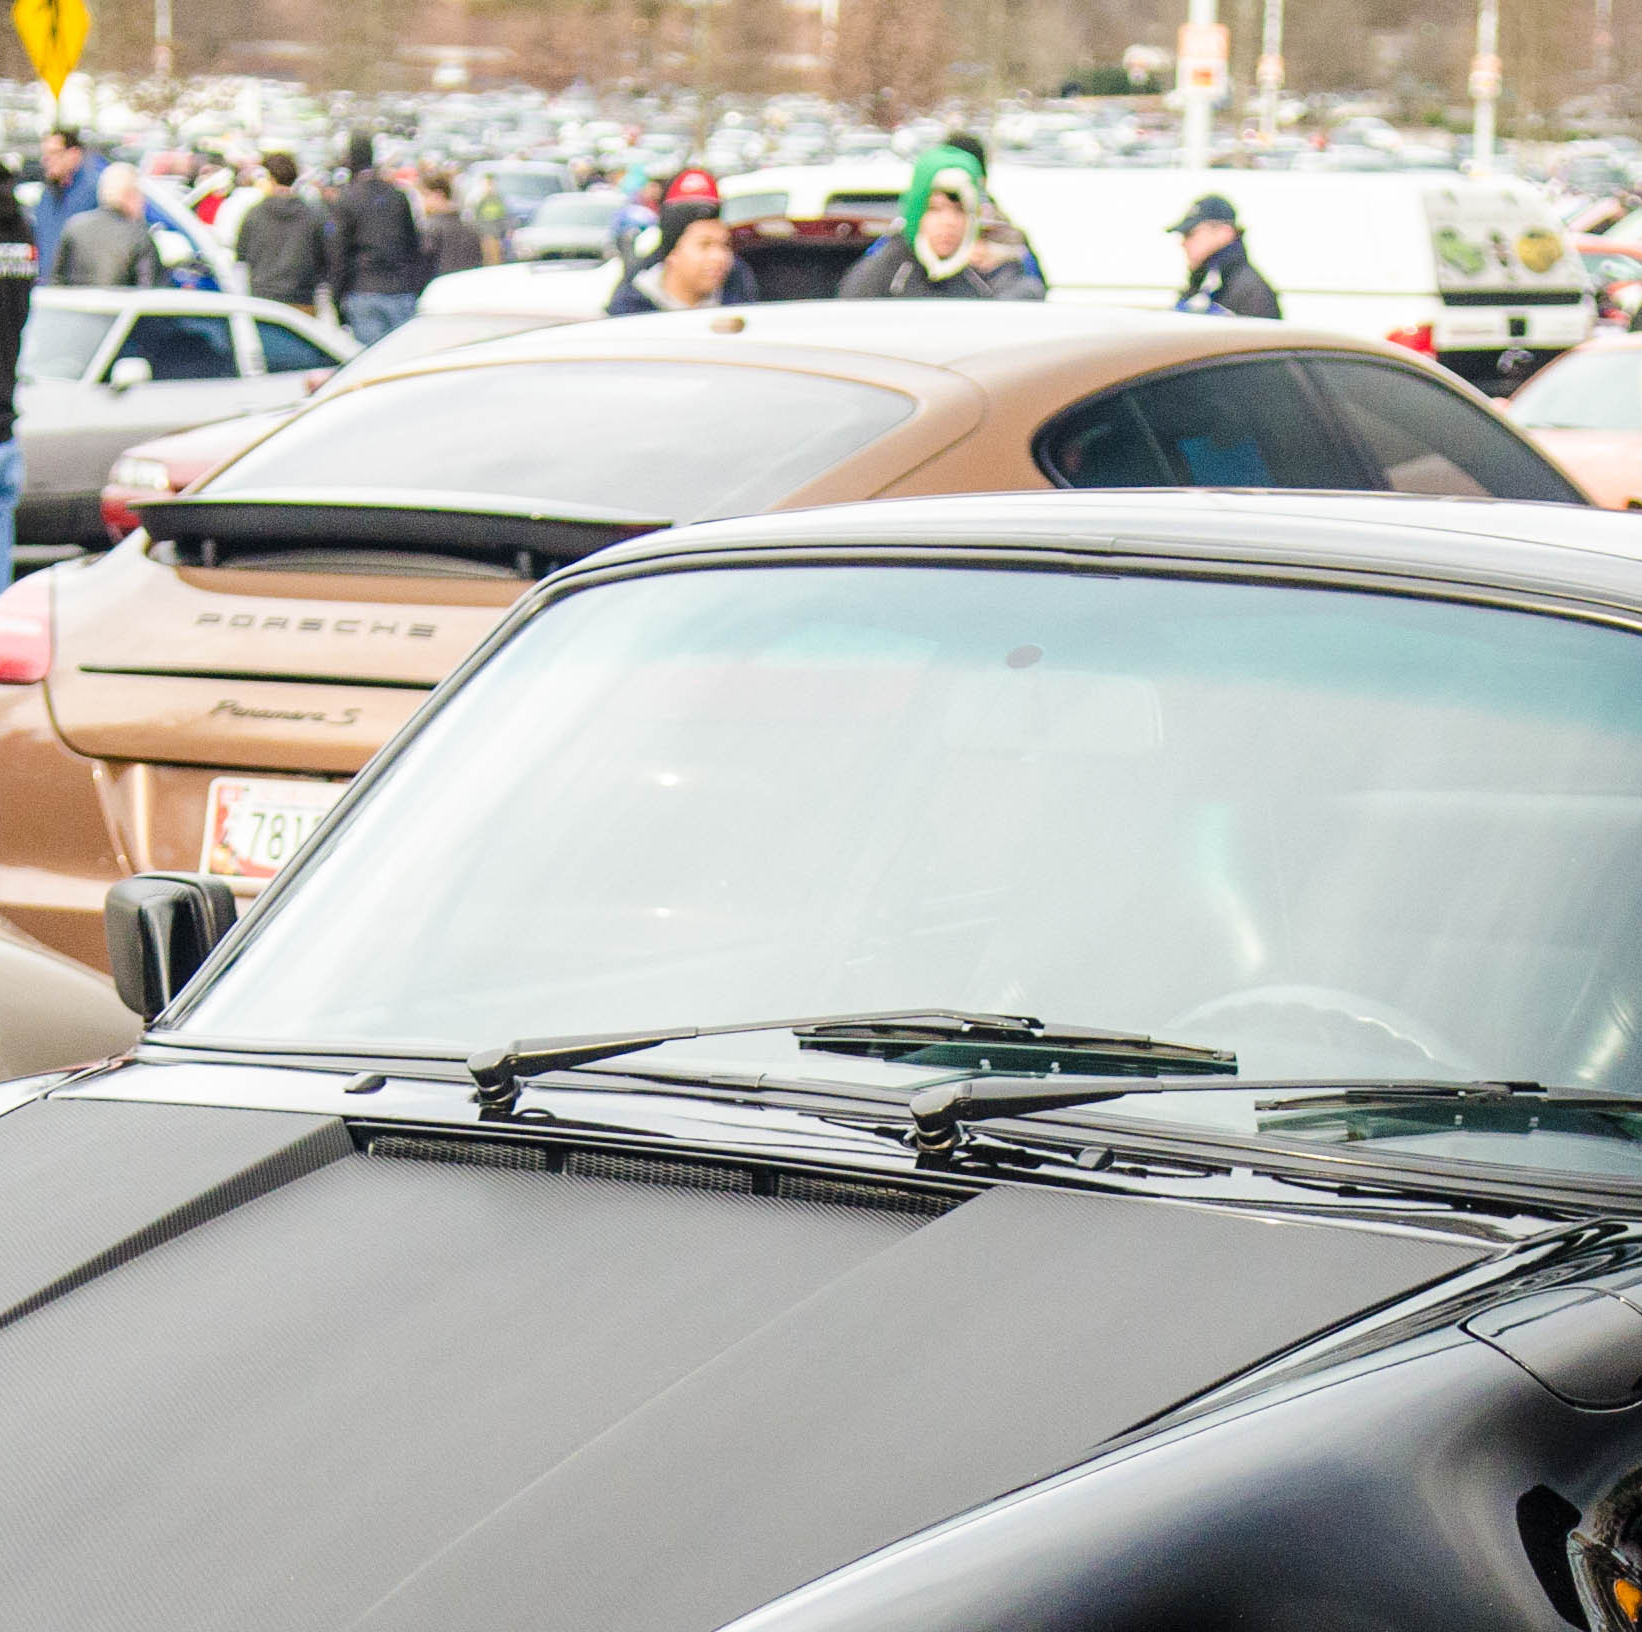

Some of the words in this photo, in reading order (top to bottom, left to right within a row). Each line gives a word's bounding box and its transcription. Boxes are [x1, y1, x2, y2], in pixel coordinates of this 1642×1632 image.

[194, 612, 438, 638] PORSCHE
[208, 699, 328, 723] Panamera
[325, 708, 363, 726] S
[250, 811, 325, 861] 781
